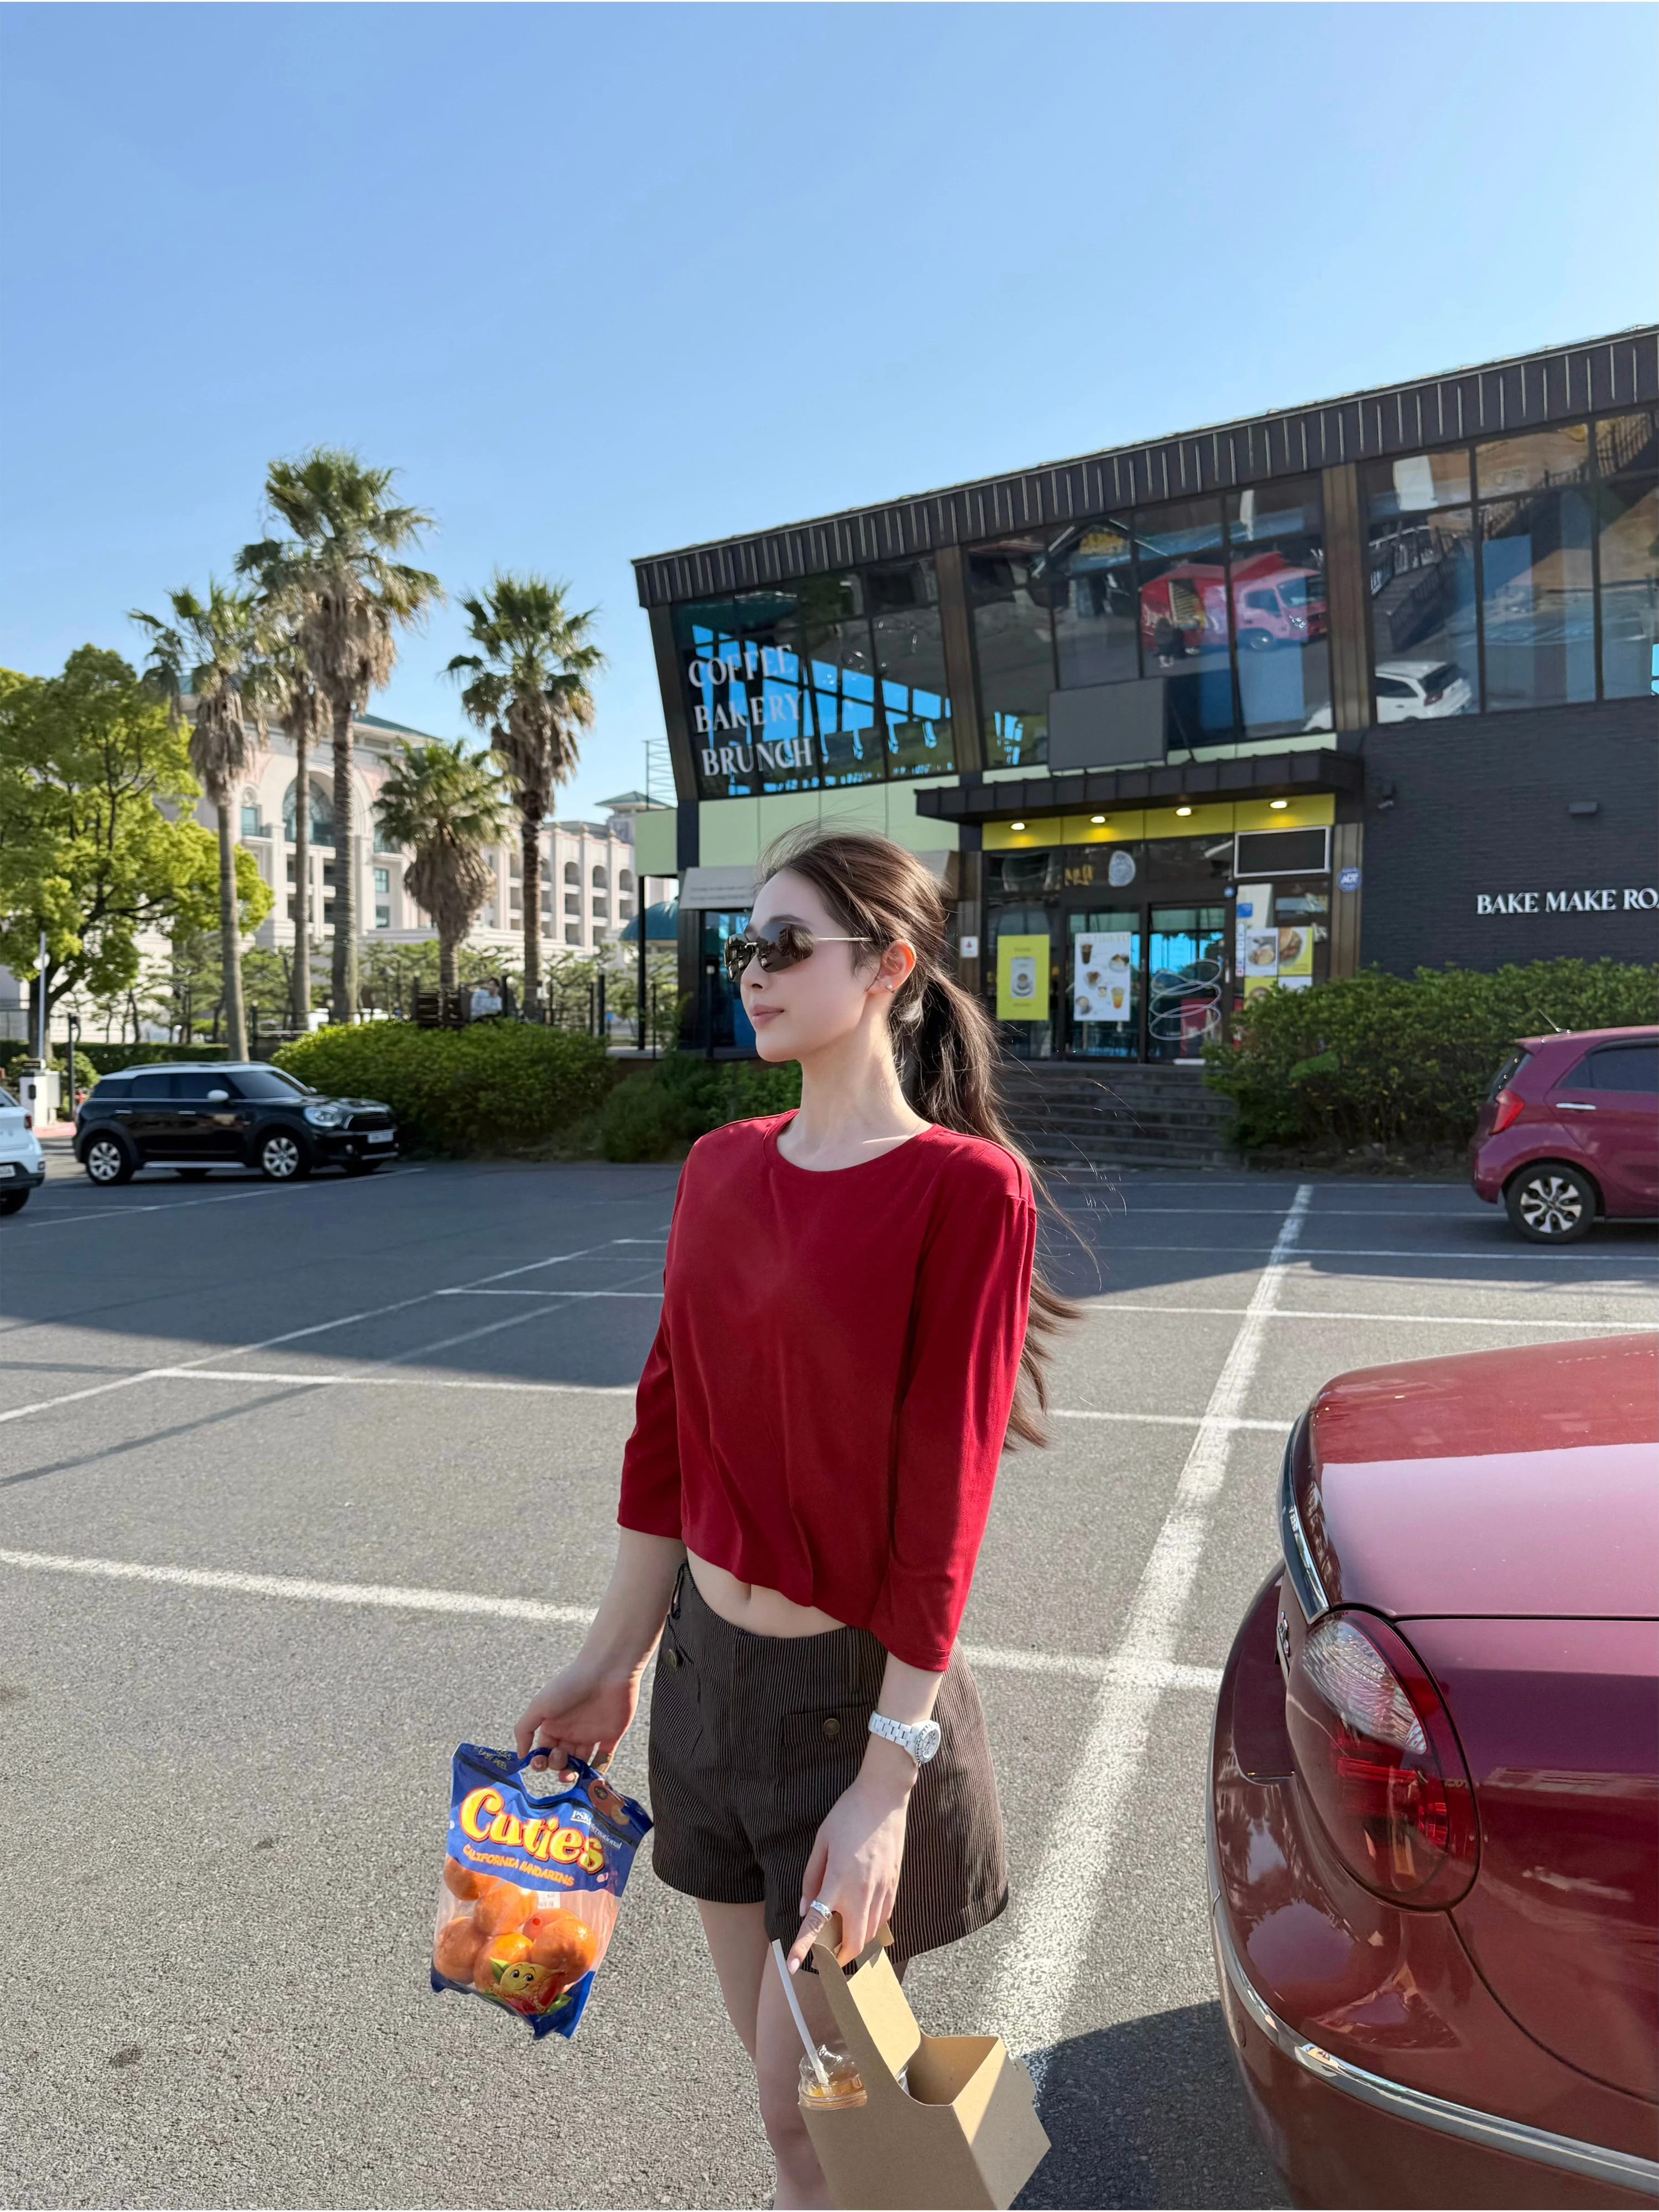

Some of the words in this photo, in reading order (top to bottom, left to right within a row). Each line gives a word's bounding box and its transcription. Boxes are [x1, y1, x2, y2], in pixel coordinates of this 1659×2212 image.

[688, 644, 793, 688] COFFEE
[693, 691, 802, 733] BAKERY
[701, 737, 813, 776] BRUNCH
[1477, 892, 1540, 915] BAKE
[1545, 889, 1616, 912] MAKE
[1623, 888, 1658, 910] RO
[459, 1787, 604, 1874] Cuties
[463, 1844, 520, 1869] CALIFORNIA
